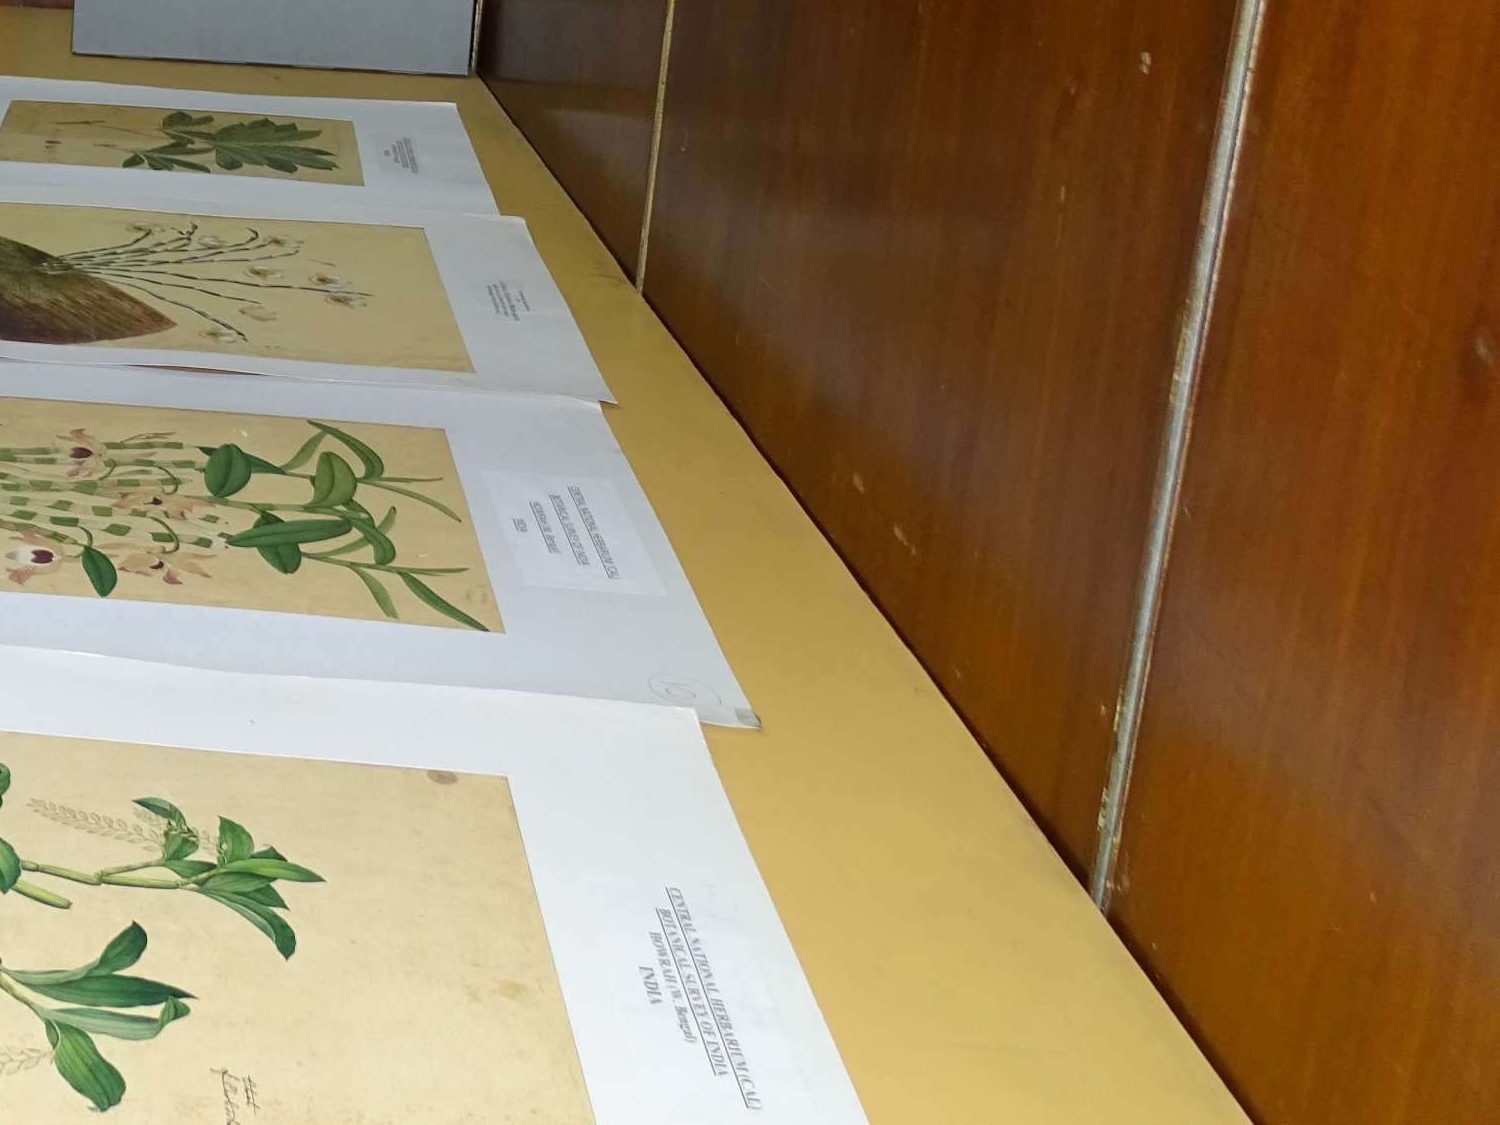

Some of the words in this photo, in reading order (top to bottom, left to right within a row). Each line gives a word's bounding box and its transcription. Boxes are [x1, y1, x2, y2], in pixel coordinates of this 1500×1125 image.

[658, 908, 692, 968] BOTANICAL
[638, 966, 663, 1005] INDIA
[648, 931, 678, 984] HOWRAH
[674, 1005, 698, 1044] Bengal)
[668, 887, 697, 932] CENTRAL
[691, 937, 720, 993] NATIONAL
[710, 997, 750, 1072] HERBARIUM
[737, 1074, 762, 1110] (CAL)
[683, 974, 708, 1016] SURVEY
[700, 1021, 717, 1038] OF
[706, 1040, 729, 1076] INDIA
